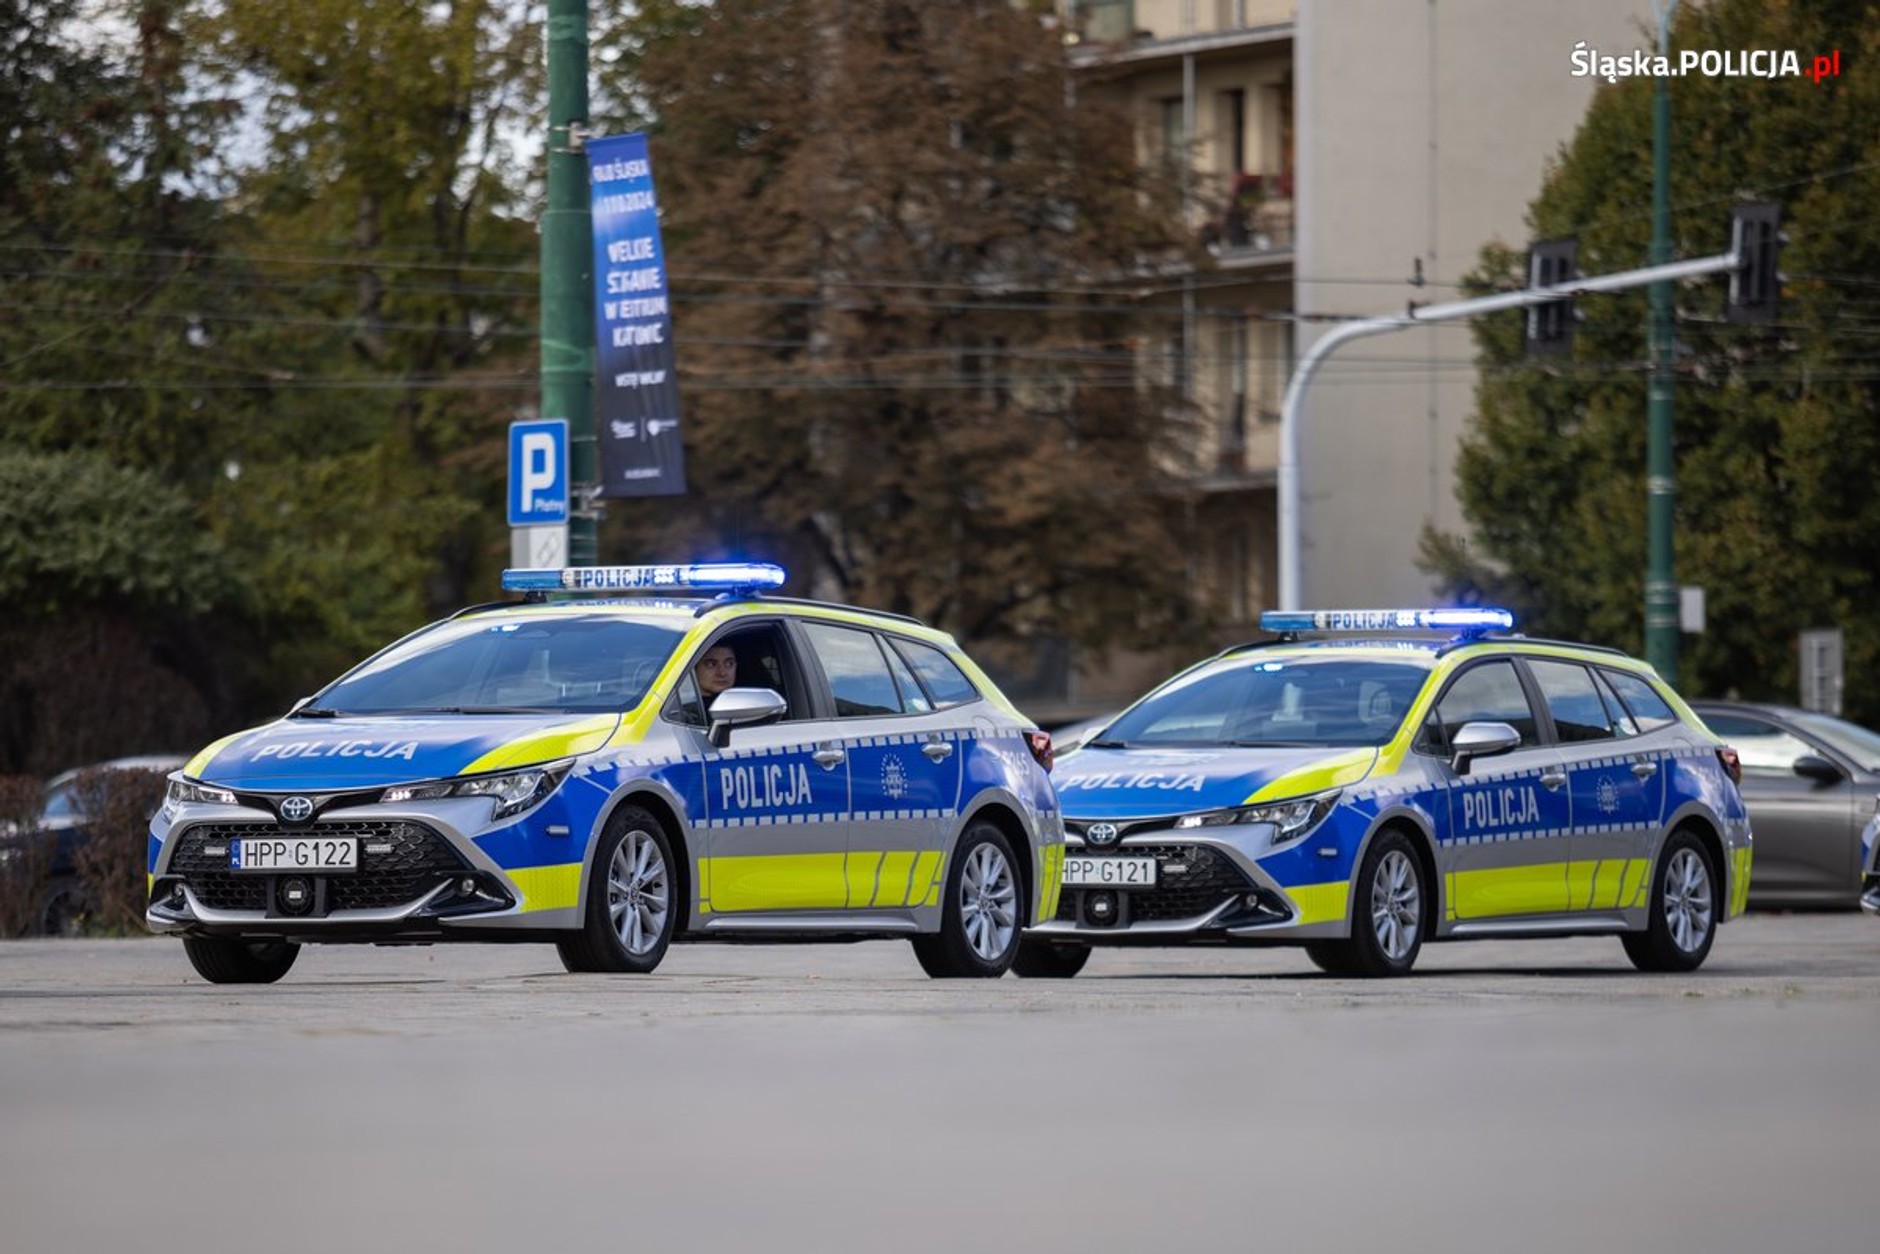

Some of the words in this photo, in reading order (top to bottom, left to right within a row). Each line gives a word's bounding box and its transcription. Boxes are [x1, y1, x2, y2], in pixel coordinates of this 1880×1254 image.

[521, 433, 556, 513] P
[583, 568, 653, 588] POLICJA
[1332, 612, 1398, 629] POLICJA
[250, 739, 419, 762] POLICJA
[720, 764, 813, 810] POLICJA
[1058, 773, 1206, 792] POLICJA
[1463, 786, 1540, 830] POLICJA
[245, 842, 287, 866] HPP
[295, 841, 351, 866] G122
[1100, 860, 1148, 882] G121
